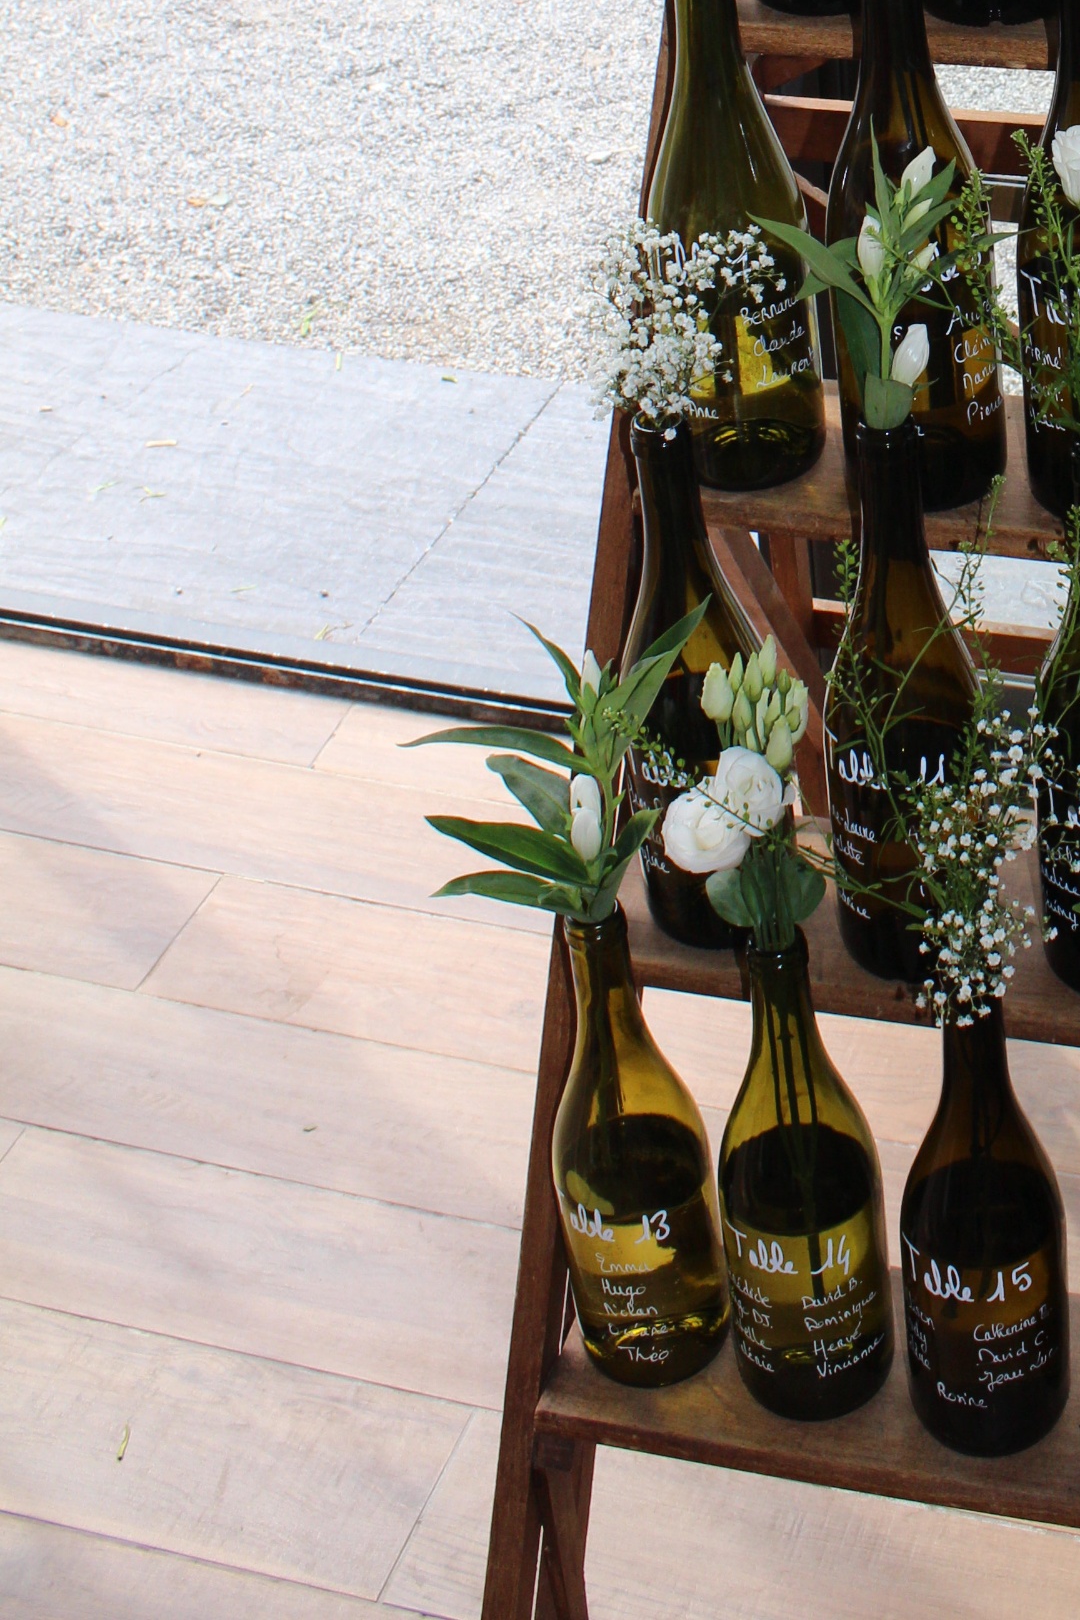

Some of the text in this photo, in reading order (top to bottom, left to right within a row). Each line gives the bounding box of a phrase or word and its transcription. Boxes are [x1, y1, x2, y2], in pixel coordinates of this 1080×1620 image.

[570, 1202, 671, 1245] able 13
[725, 1218, 850, 1276] Table 14
[595, 1252, 653, 1274] Emma
[902, 1231, 1032, 1303] Table 15
[601, 1277, 647, 1305] Hugo
[801, 1284, 846, 1310] David
[973, 1315, 1037, 1342] Catherine
[617, 1345, 670, 1363] Théo
[976, 1340, 1029, 1367] David
